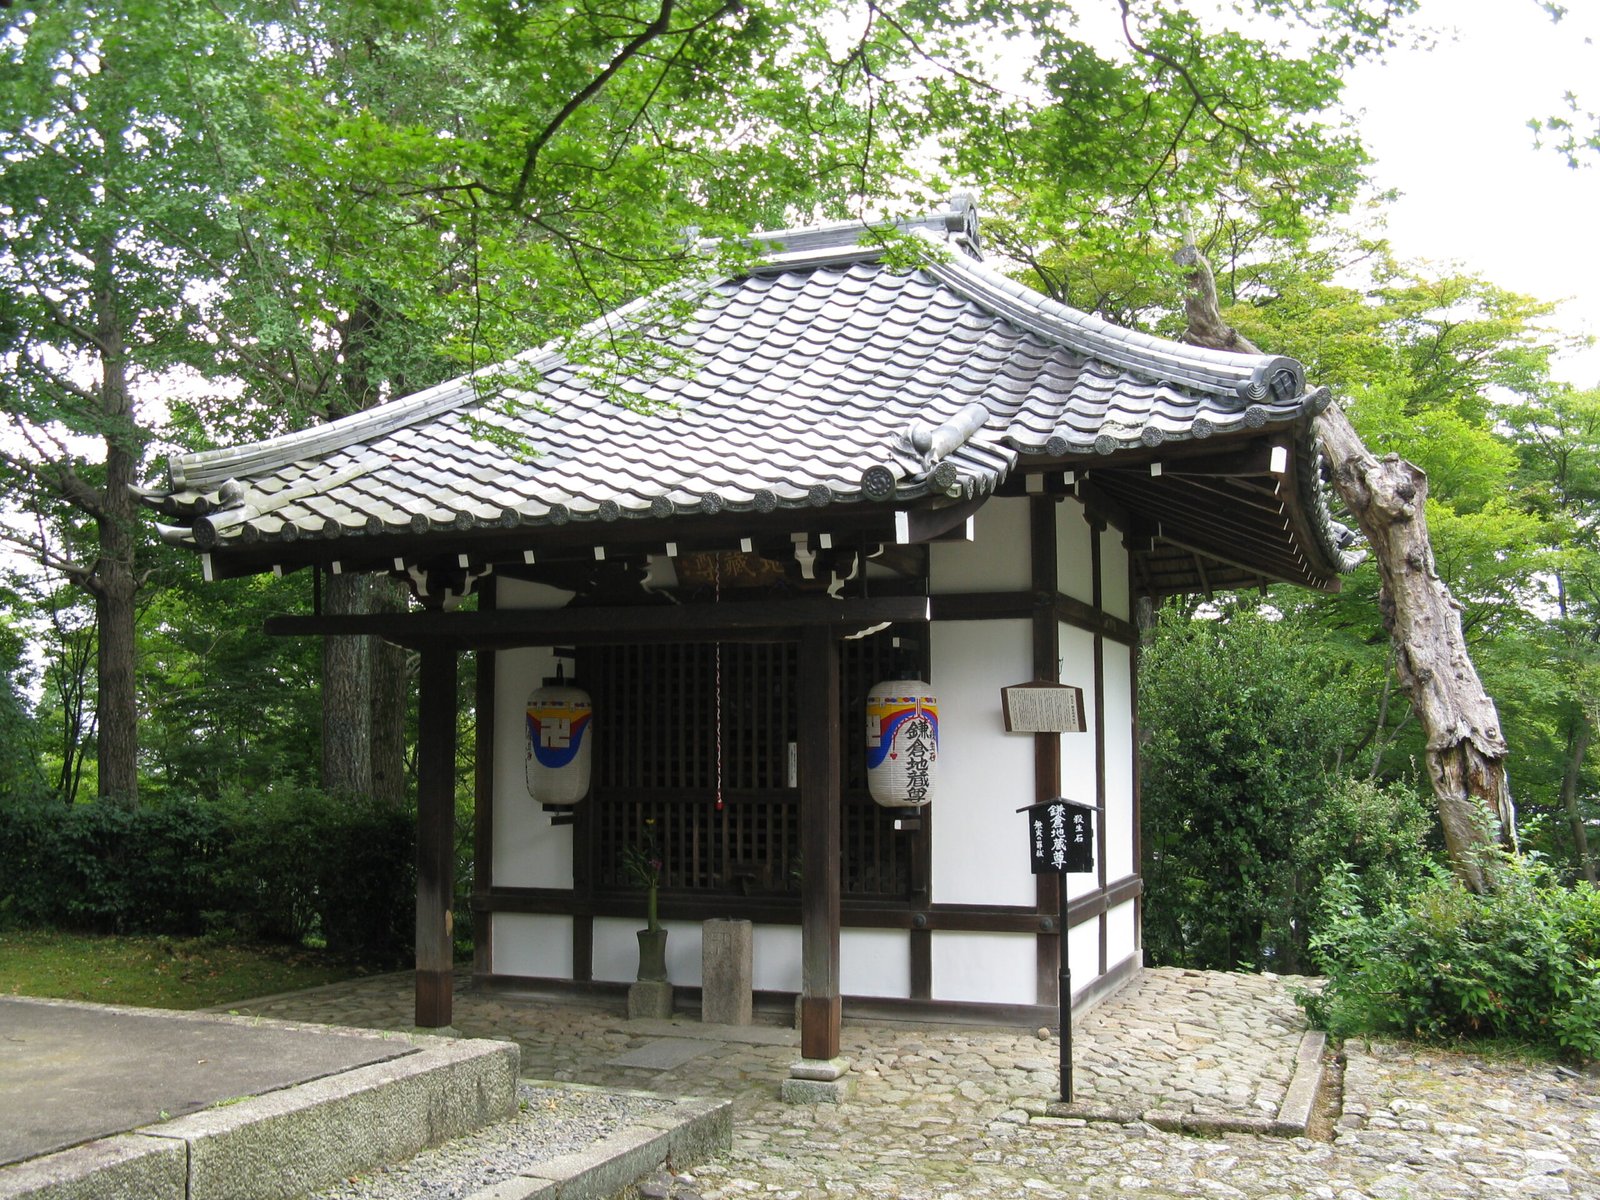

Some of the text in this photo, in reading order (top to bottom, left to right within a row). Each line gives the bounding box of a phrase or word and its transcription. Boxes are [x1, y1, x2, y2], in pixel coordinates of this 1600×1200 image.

[903, 719, 930, 803] 鎌倉地蔵尊
[1047, 803, 1067, 870] 鎌倉地蔵尊
[1073, 814, 1084, 843] 殺生石
